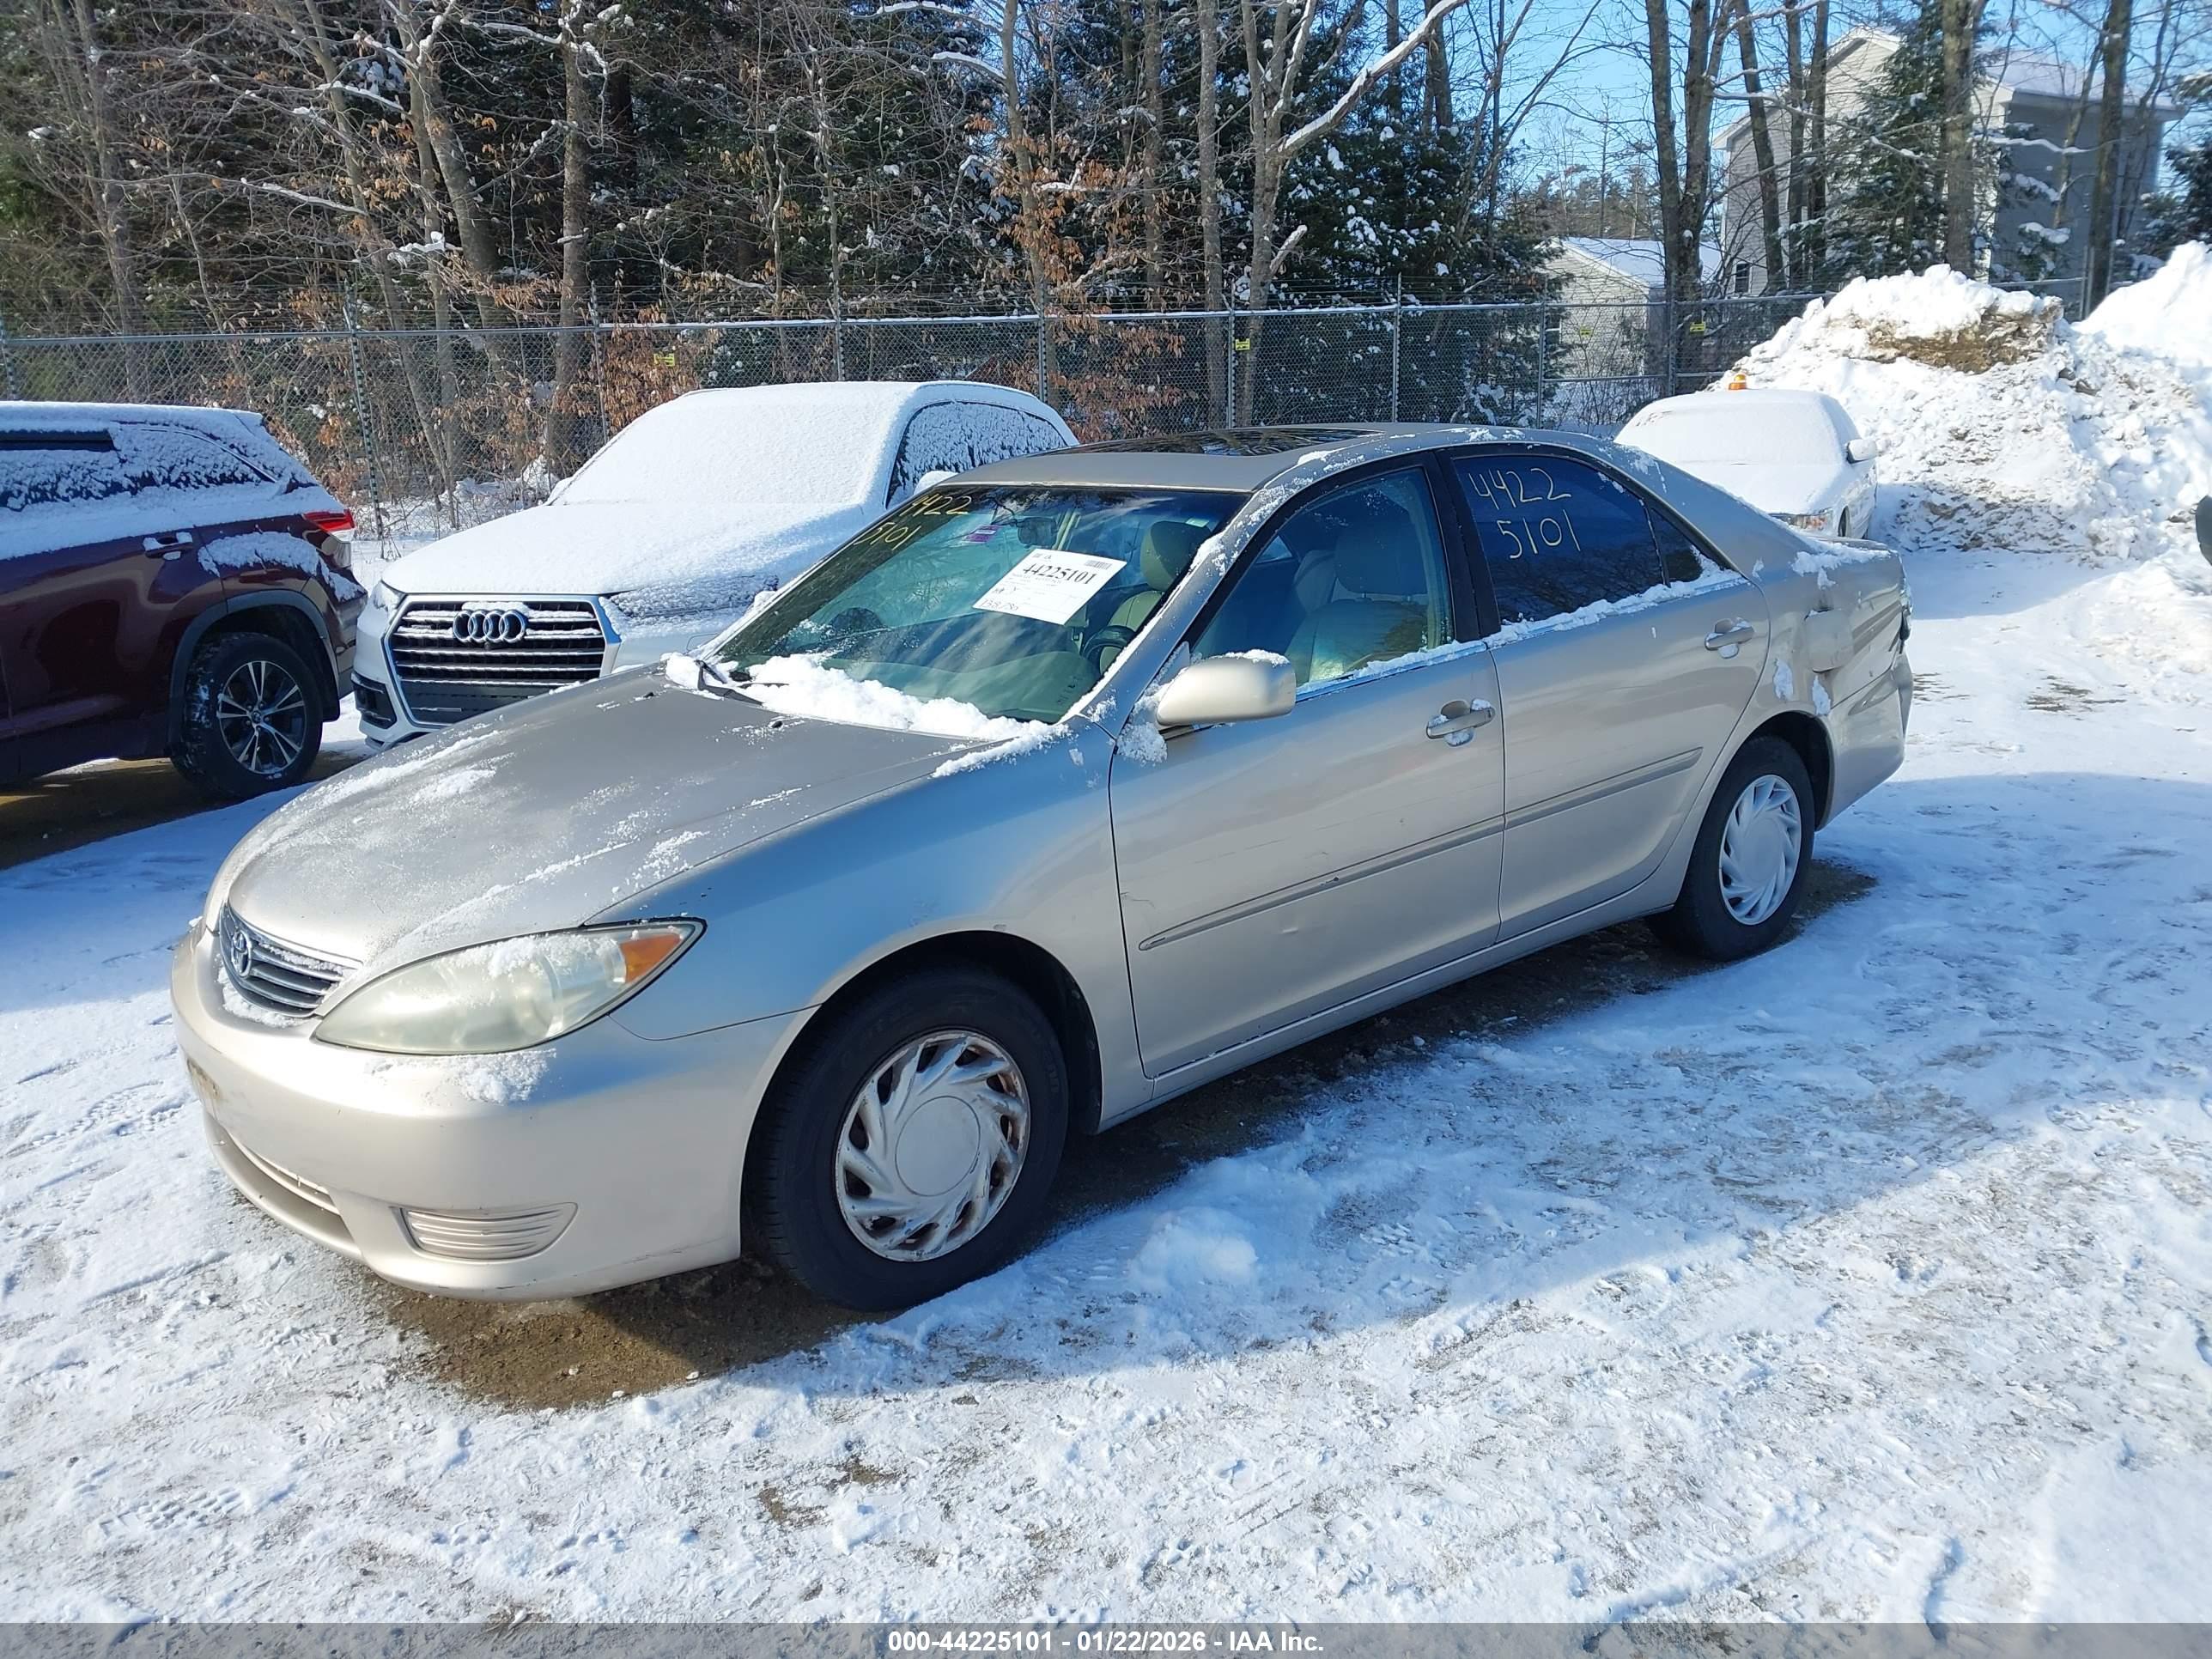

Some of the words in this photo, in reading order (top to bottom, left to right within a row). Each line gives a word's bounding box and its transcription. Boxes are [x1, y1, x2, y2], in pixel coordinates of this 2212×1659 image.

[1468, 467, 1572, 510] 4422
[899, 493, 972, 517] 4422
[853, 521, 922, 551] 5101
[1497, 508, 1581, 559] 5101
[1023, 562, 1097, 585] 44225101
